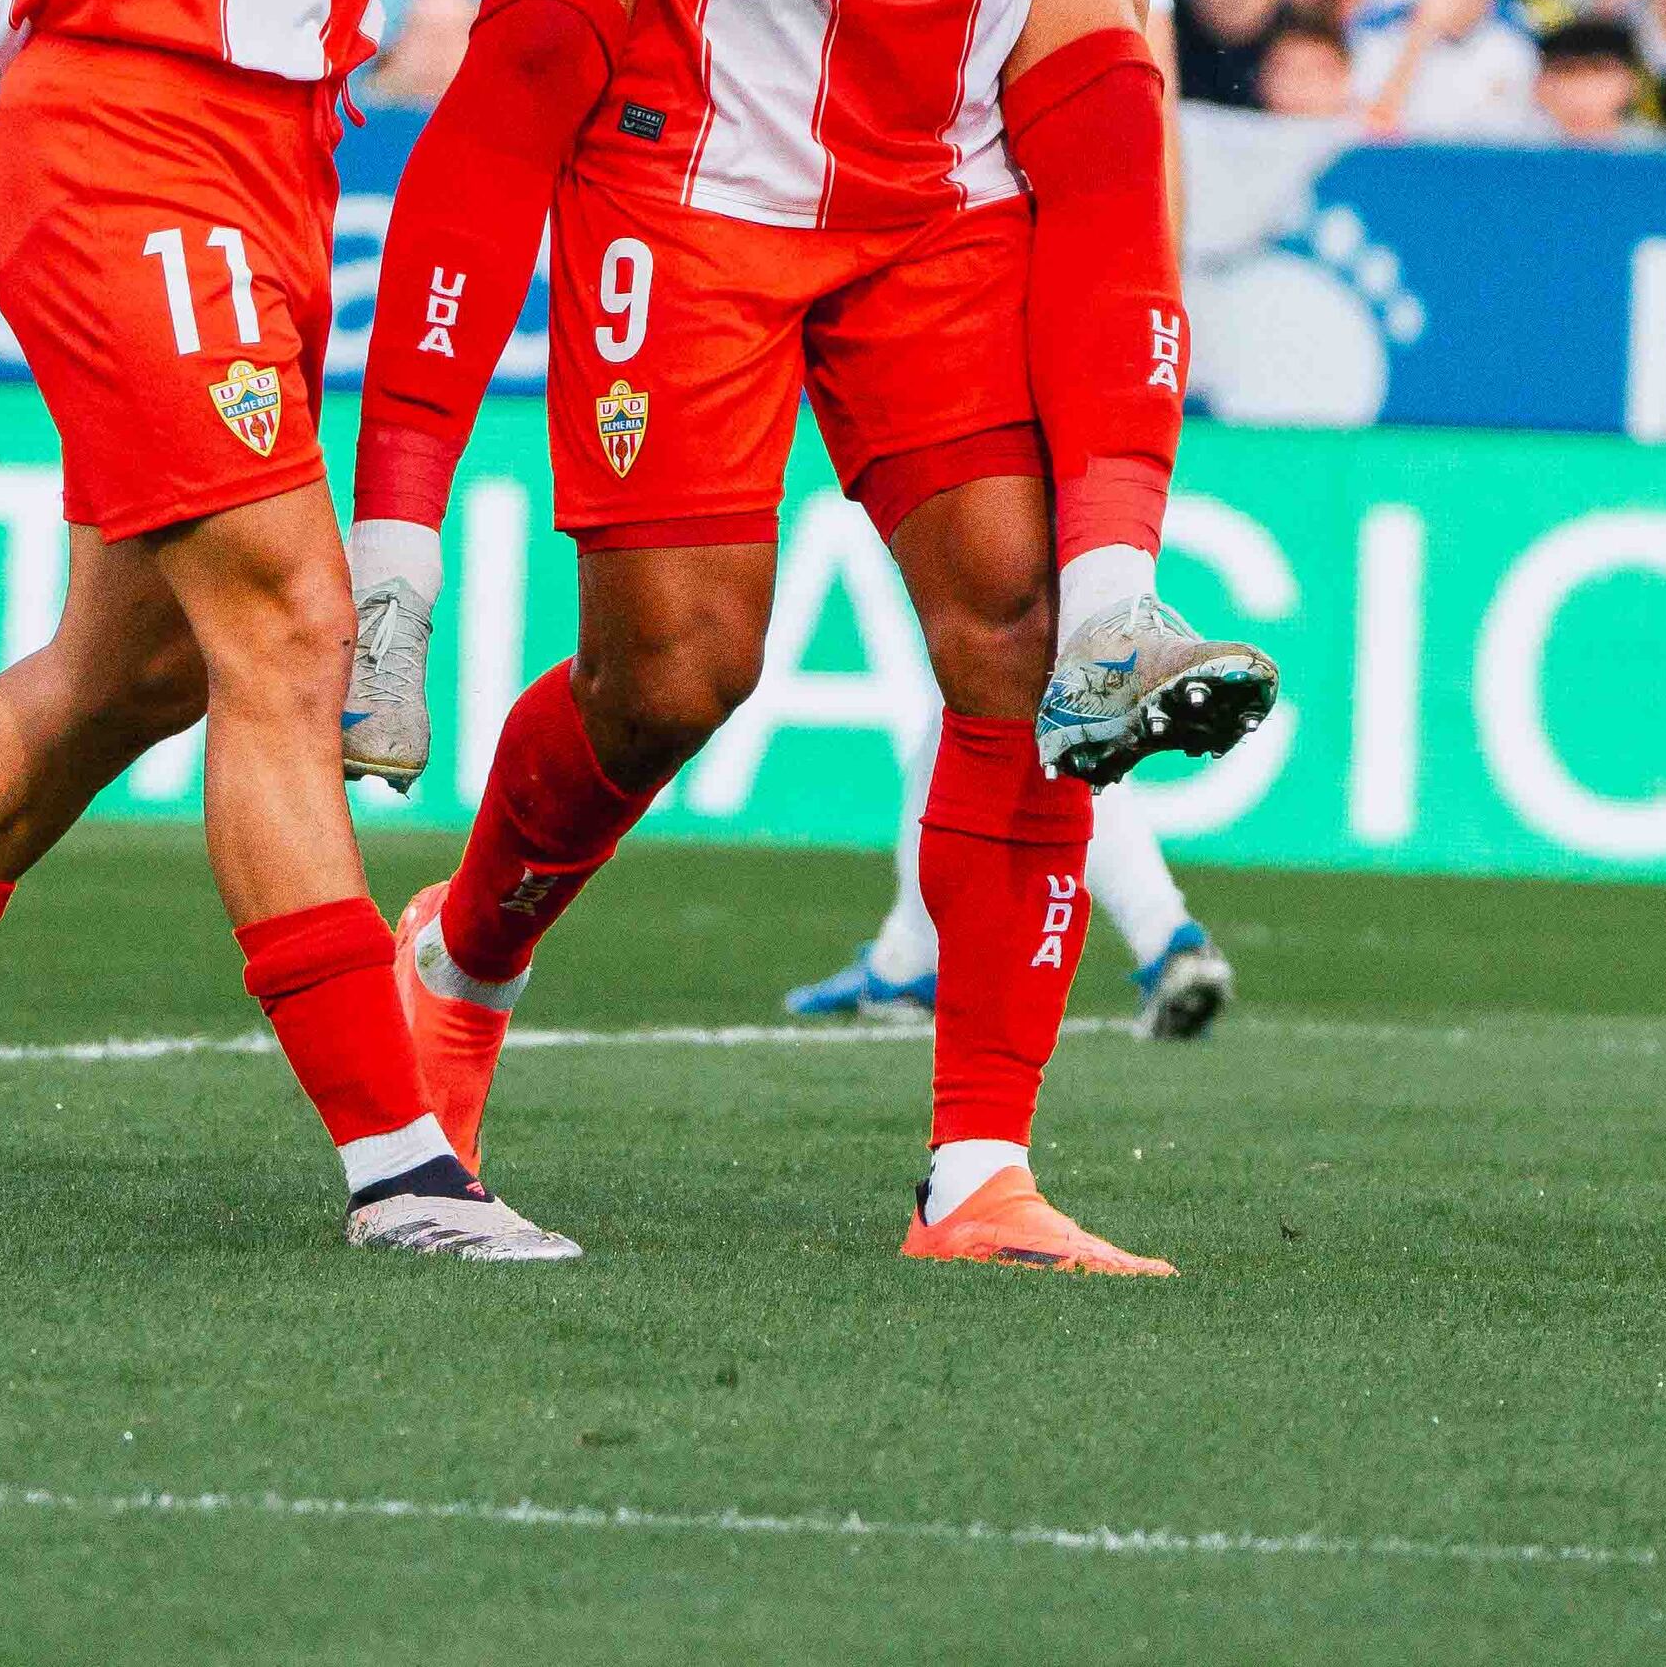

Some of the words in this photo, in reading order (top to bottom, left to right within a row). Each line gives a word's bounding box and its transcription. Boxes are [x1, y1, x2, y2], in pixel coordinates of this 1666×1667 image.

[142, 226, 261, 356] 11
[417, 265, 467, 359] UDA
[595, 237, 653, 363] 9
[1148, 308, 1180, 394] UDA
[1031, 874, 1077, 969] UDA
